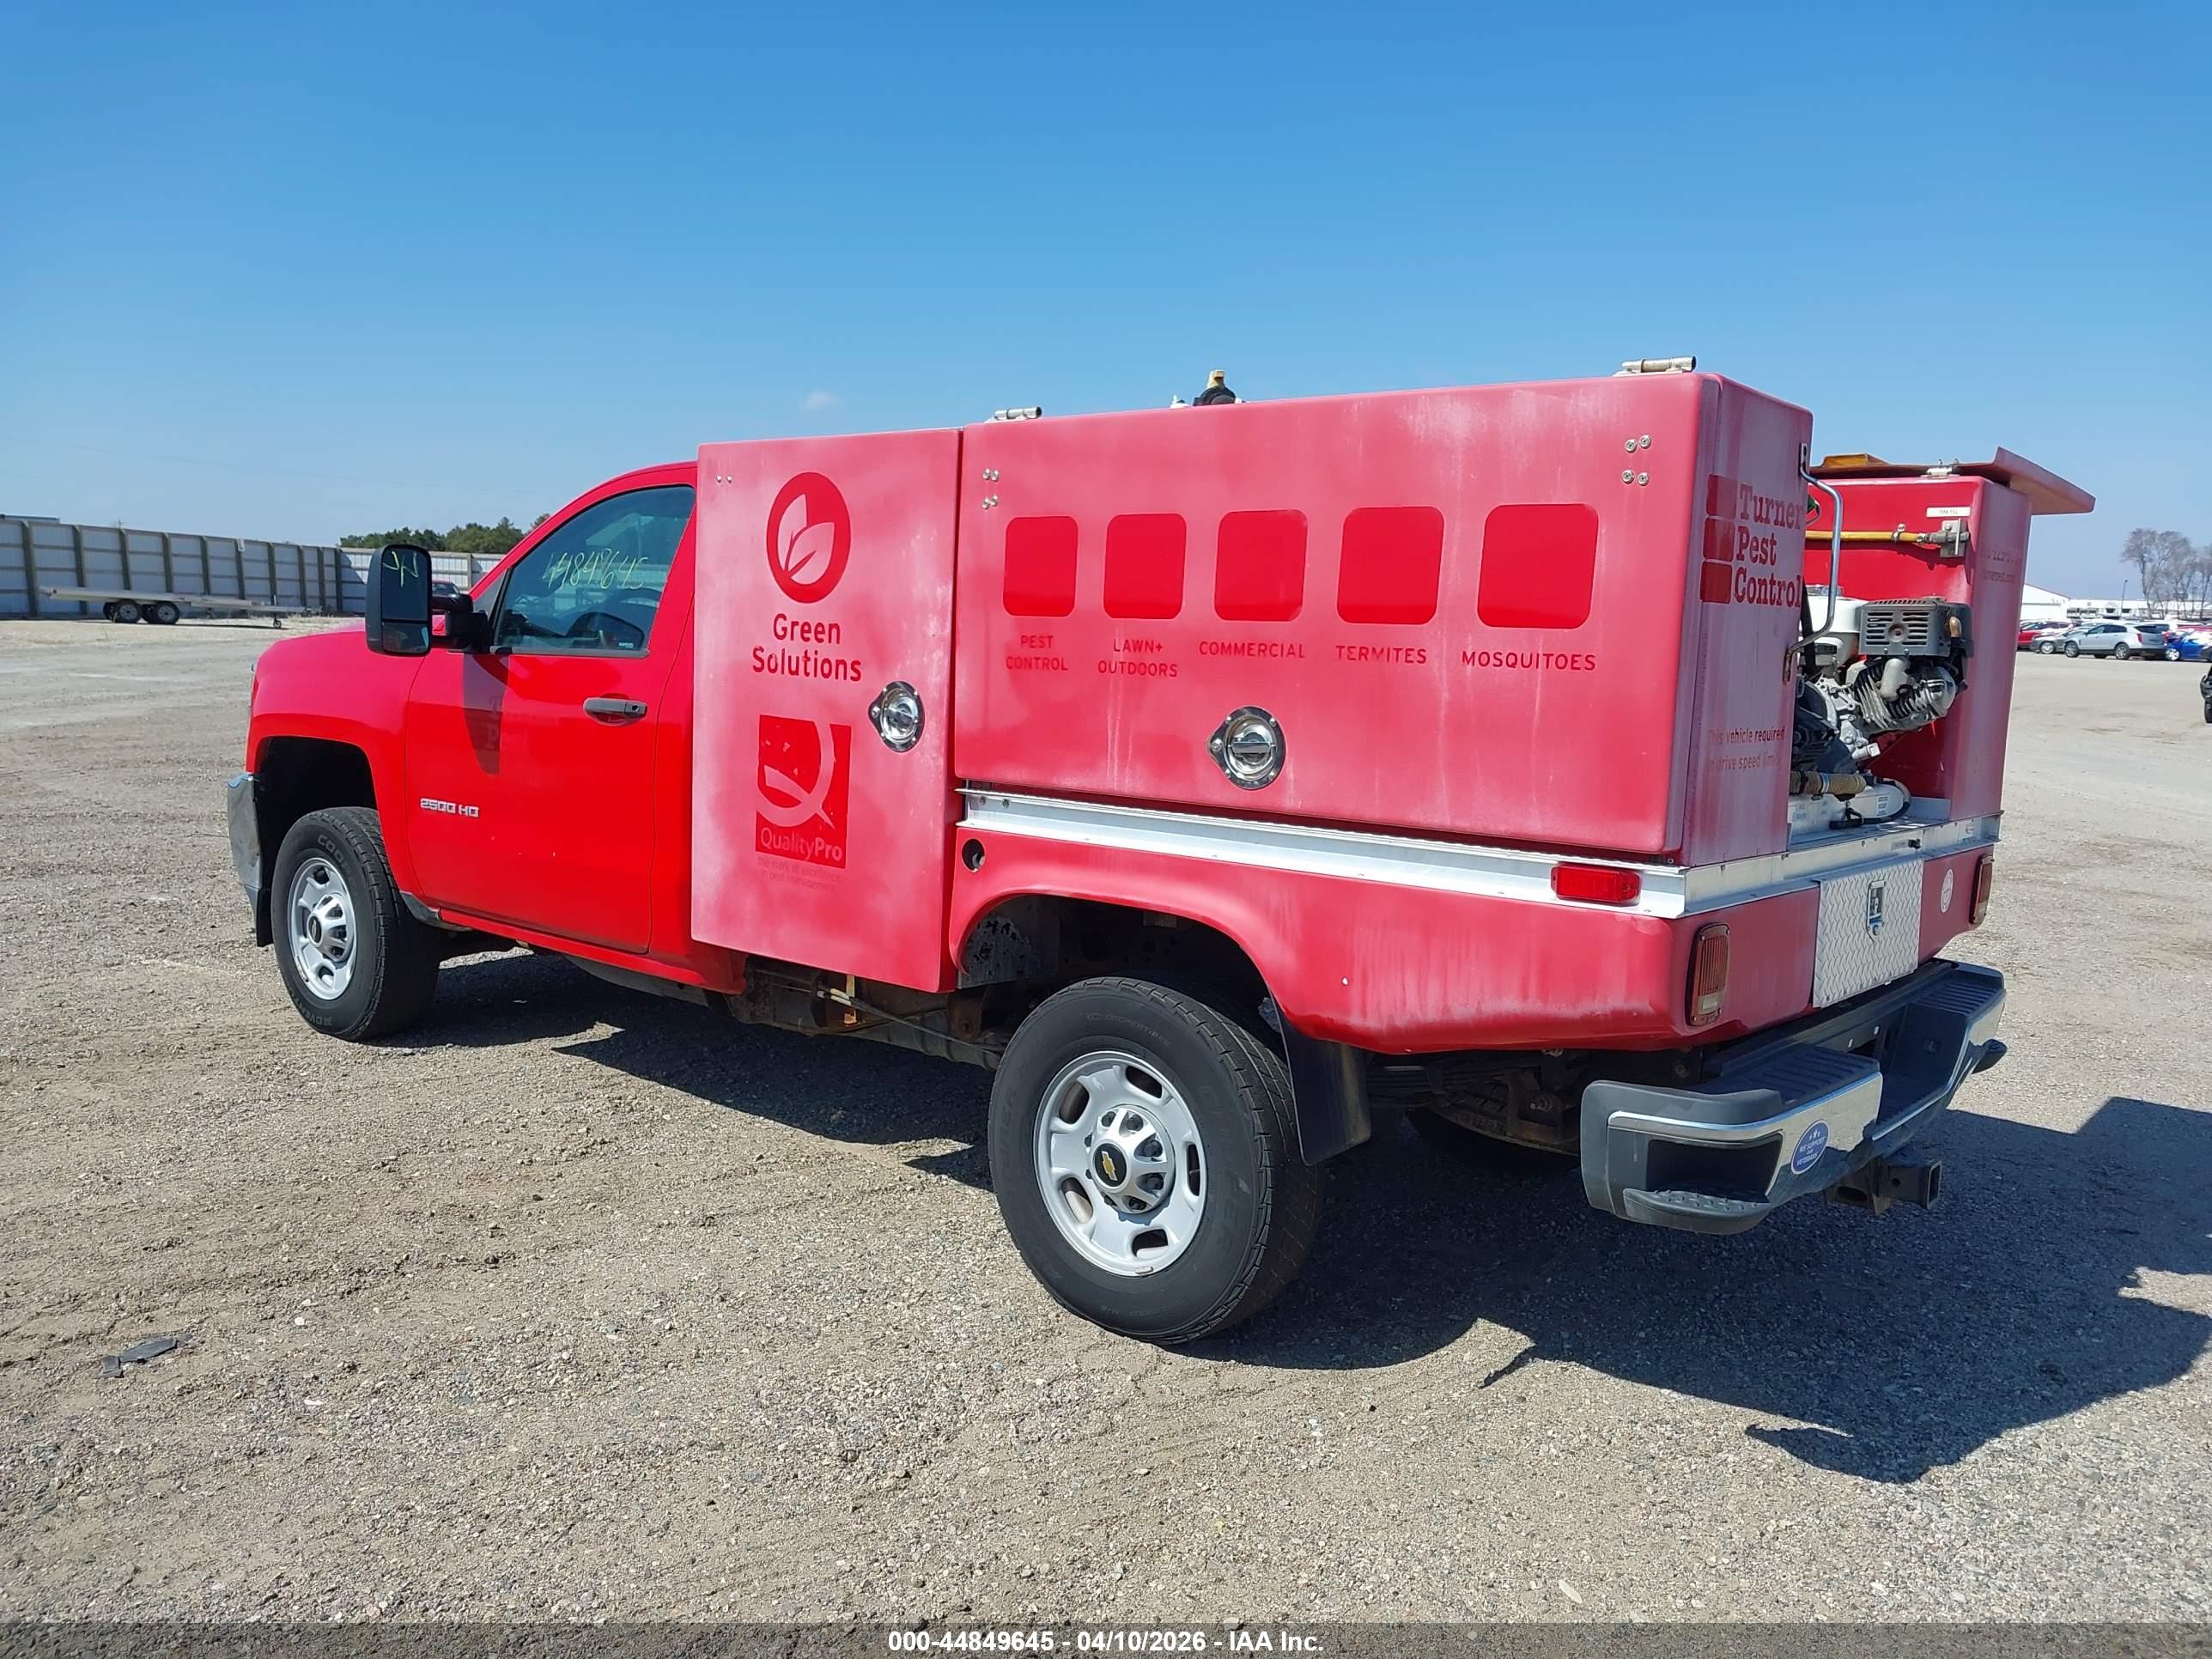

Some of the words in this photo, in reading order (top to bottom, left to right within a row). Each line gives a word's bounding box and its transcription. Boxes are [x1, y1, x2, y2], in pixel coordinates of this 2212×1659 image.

[1739, 483, 1802, 530] Turner
[1736, 526, 1778, 566] Pest
[1734, 567, 1802, 608] Control
[774, 613, 841, 644] Green
[1020, 635, 1054, 649] PEST
[1113, 638, 1164, 653] LAWN+
[1199, 641, 1306, 659] COMMERCIAL
[752, 646, 862, 682] Solutions
[1006, 656, 1069, 671] CONTROL
[1335, 645, 1427, 664] TERMITES
[1462, 651, 1596, 671] MOSQUITOES
[1097, 660, 1178, 678] OUTDOORS
[1725, 727, 1753, 744] vehicle
[1754, 725, 1786, 744] required
[1738, 754, 1761, 772] speed
[761, 827, 843, 861] QualityPro
